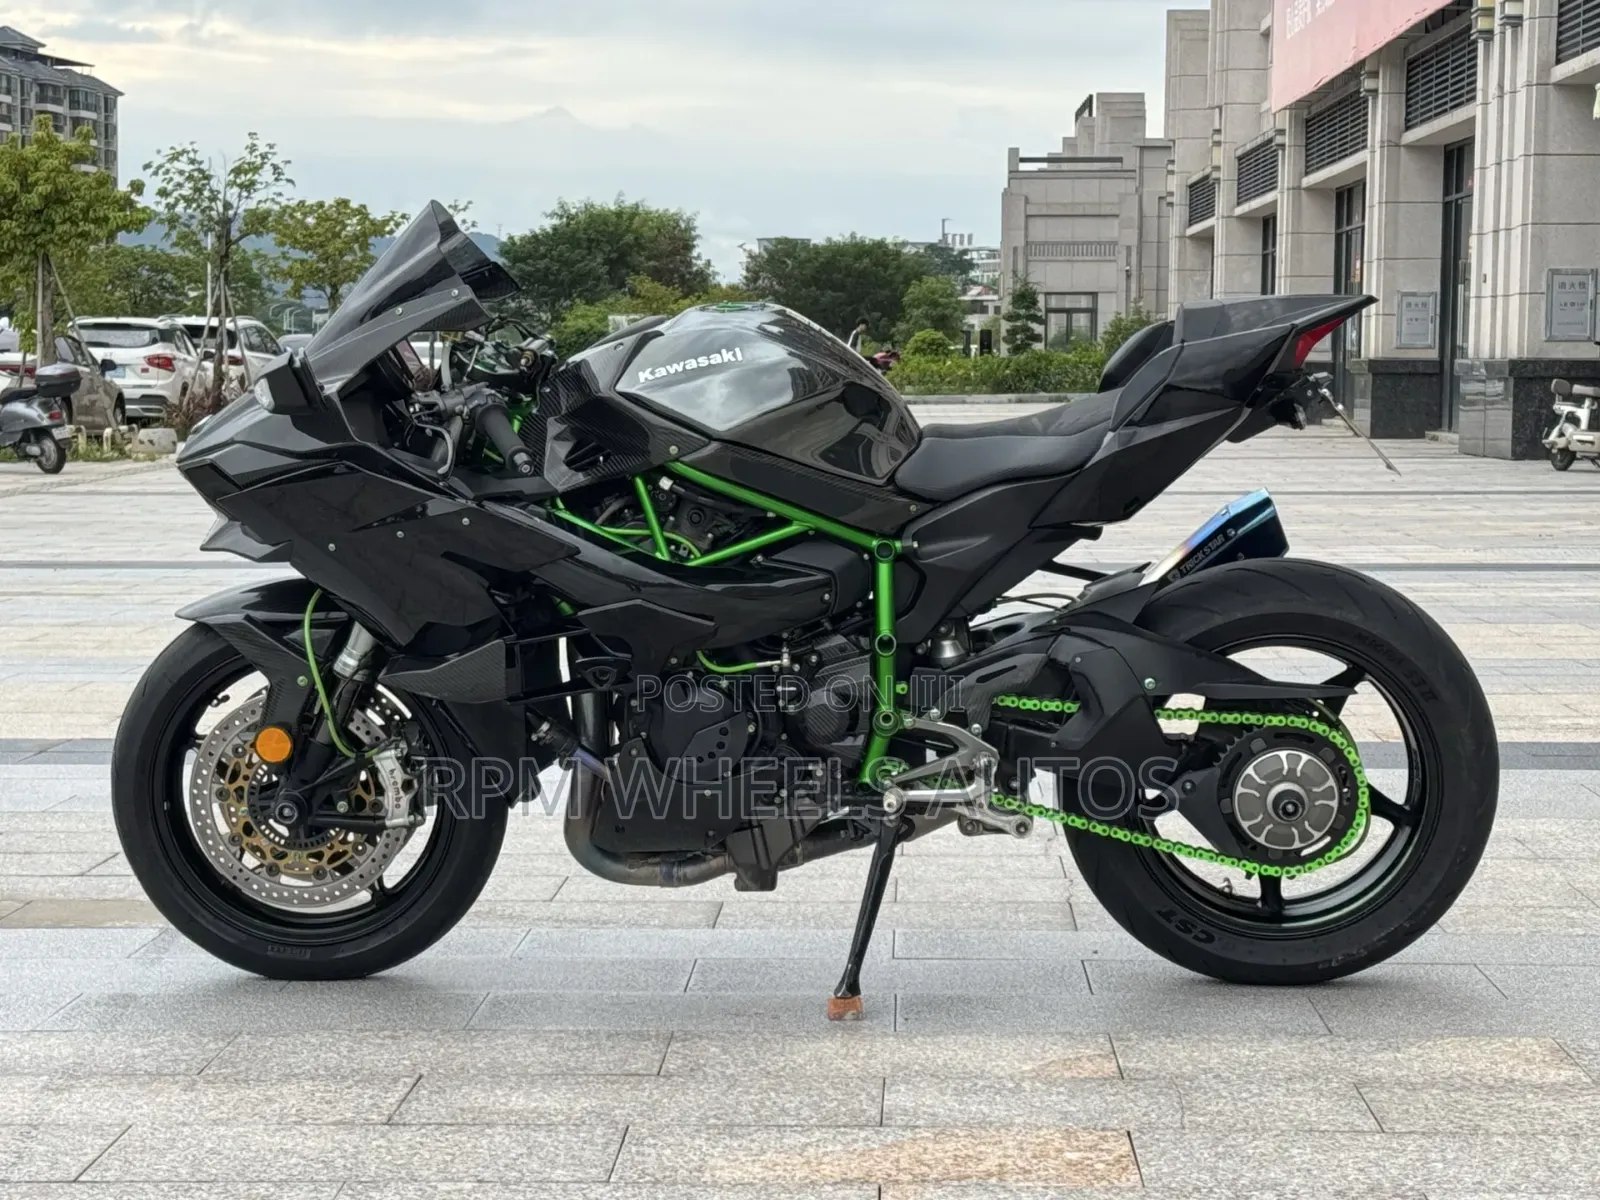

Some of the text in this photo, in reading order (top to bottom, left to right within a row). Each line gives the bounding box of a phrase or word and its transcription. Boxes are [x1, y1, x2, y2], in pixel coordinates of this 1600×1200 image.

[638, 347, 744, 384] Kawasaki
[1179, 534, 1225, 575] TRICK STAR
[388, 767, 402, 810] brembo
[1156, 908, 1216, 945] CST
